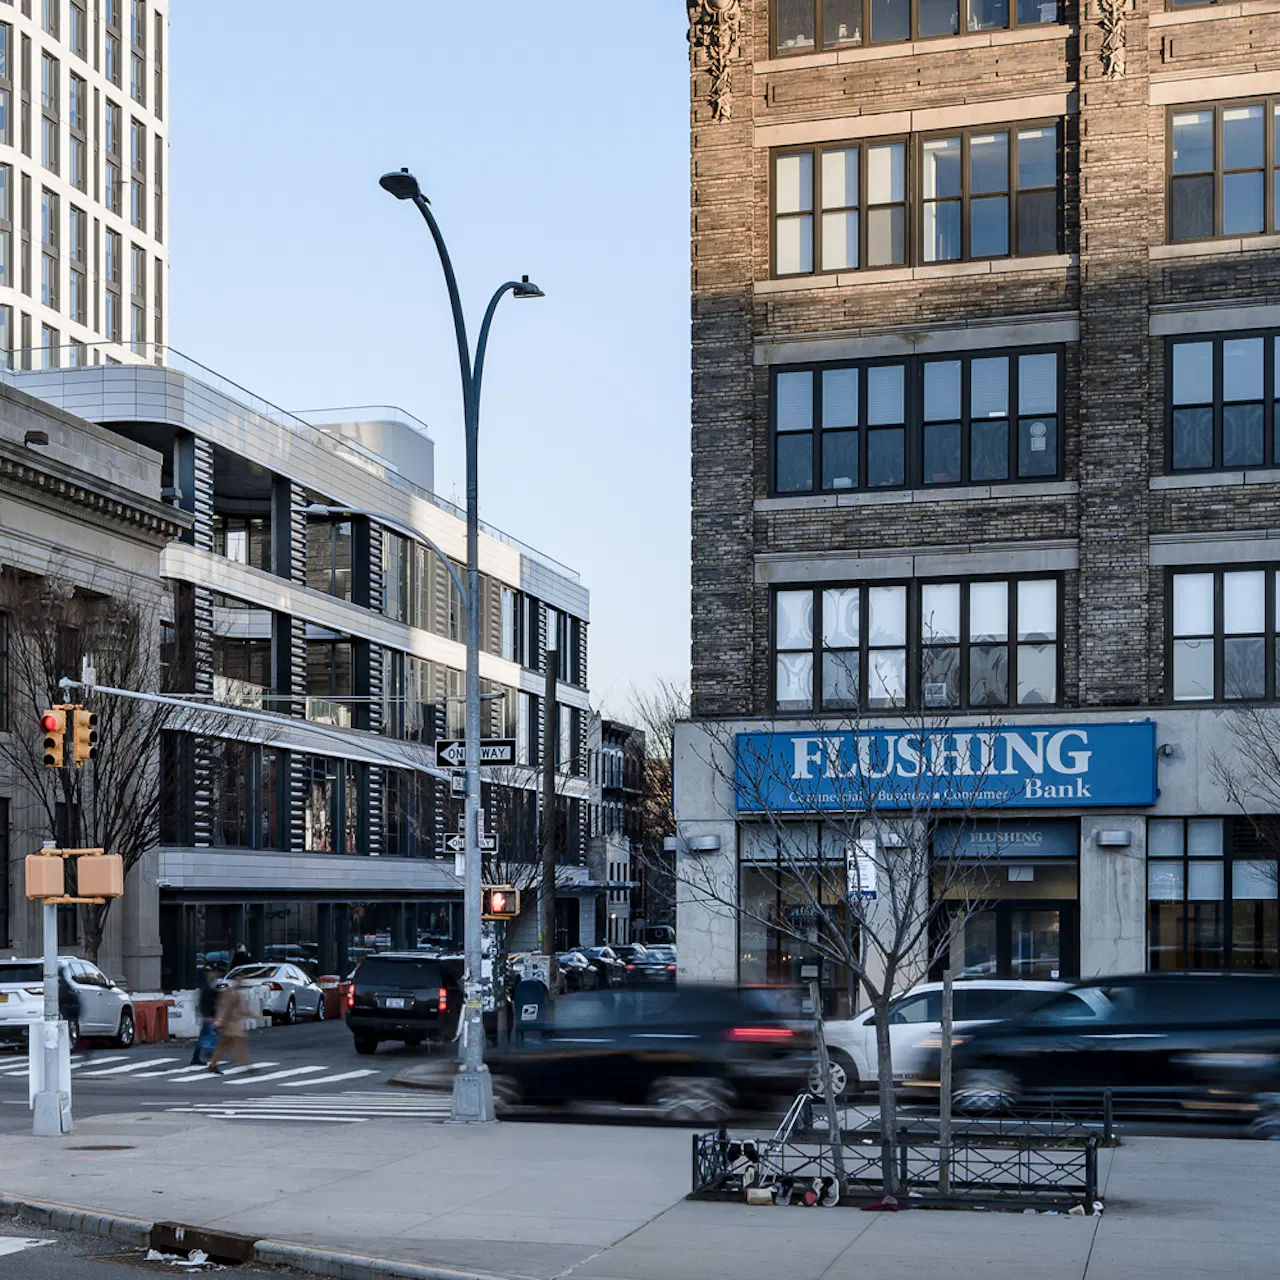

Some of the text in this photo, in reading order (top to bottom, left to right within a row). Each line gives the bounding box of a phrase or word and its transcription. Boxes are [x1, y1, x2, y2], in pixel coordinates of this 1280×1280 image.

[448, 747, 506, 760] ON WAY
[790, 729, 1092, 779] FLUSHING
[789, 789, 863, 803] Commercial
[943, 788, 1008, 801] Consumer
[1024, 776, 1093, 800] Bank
[970, 831, 1043, 842] FLUSHING
